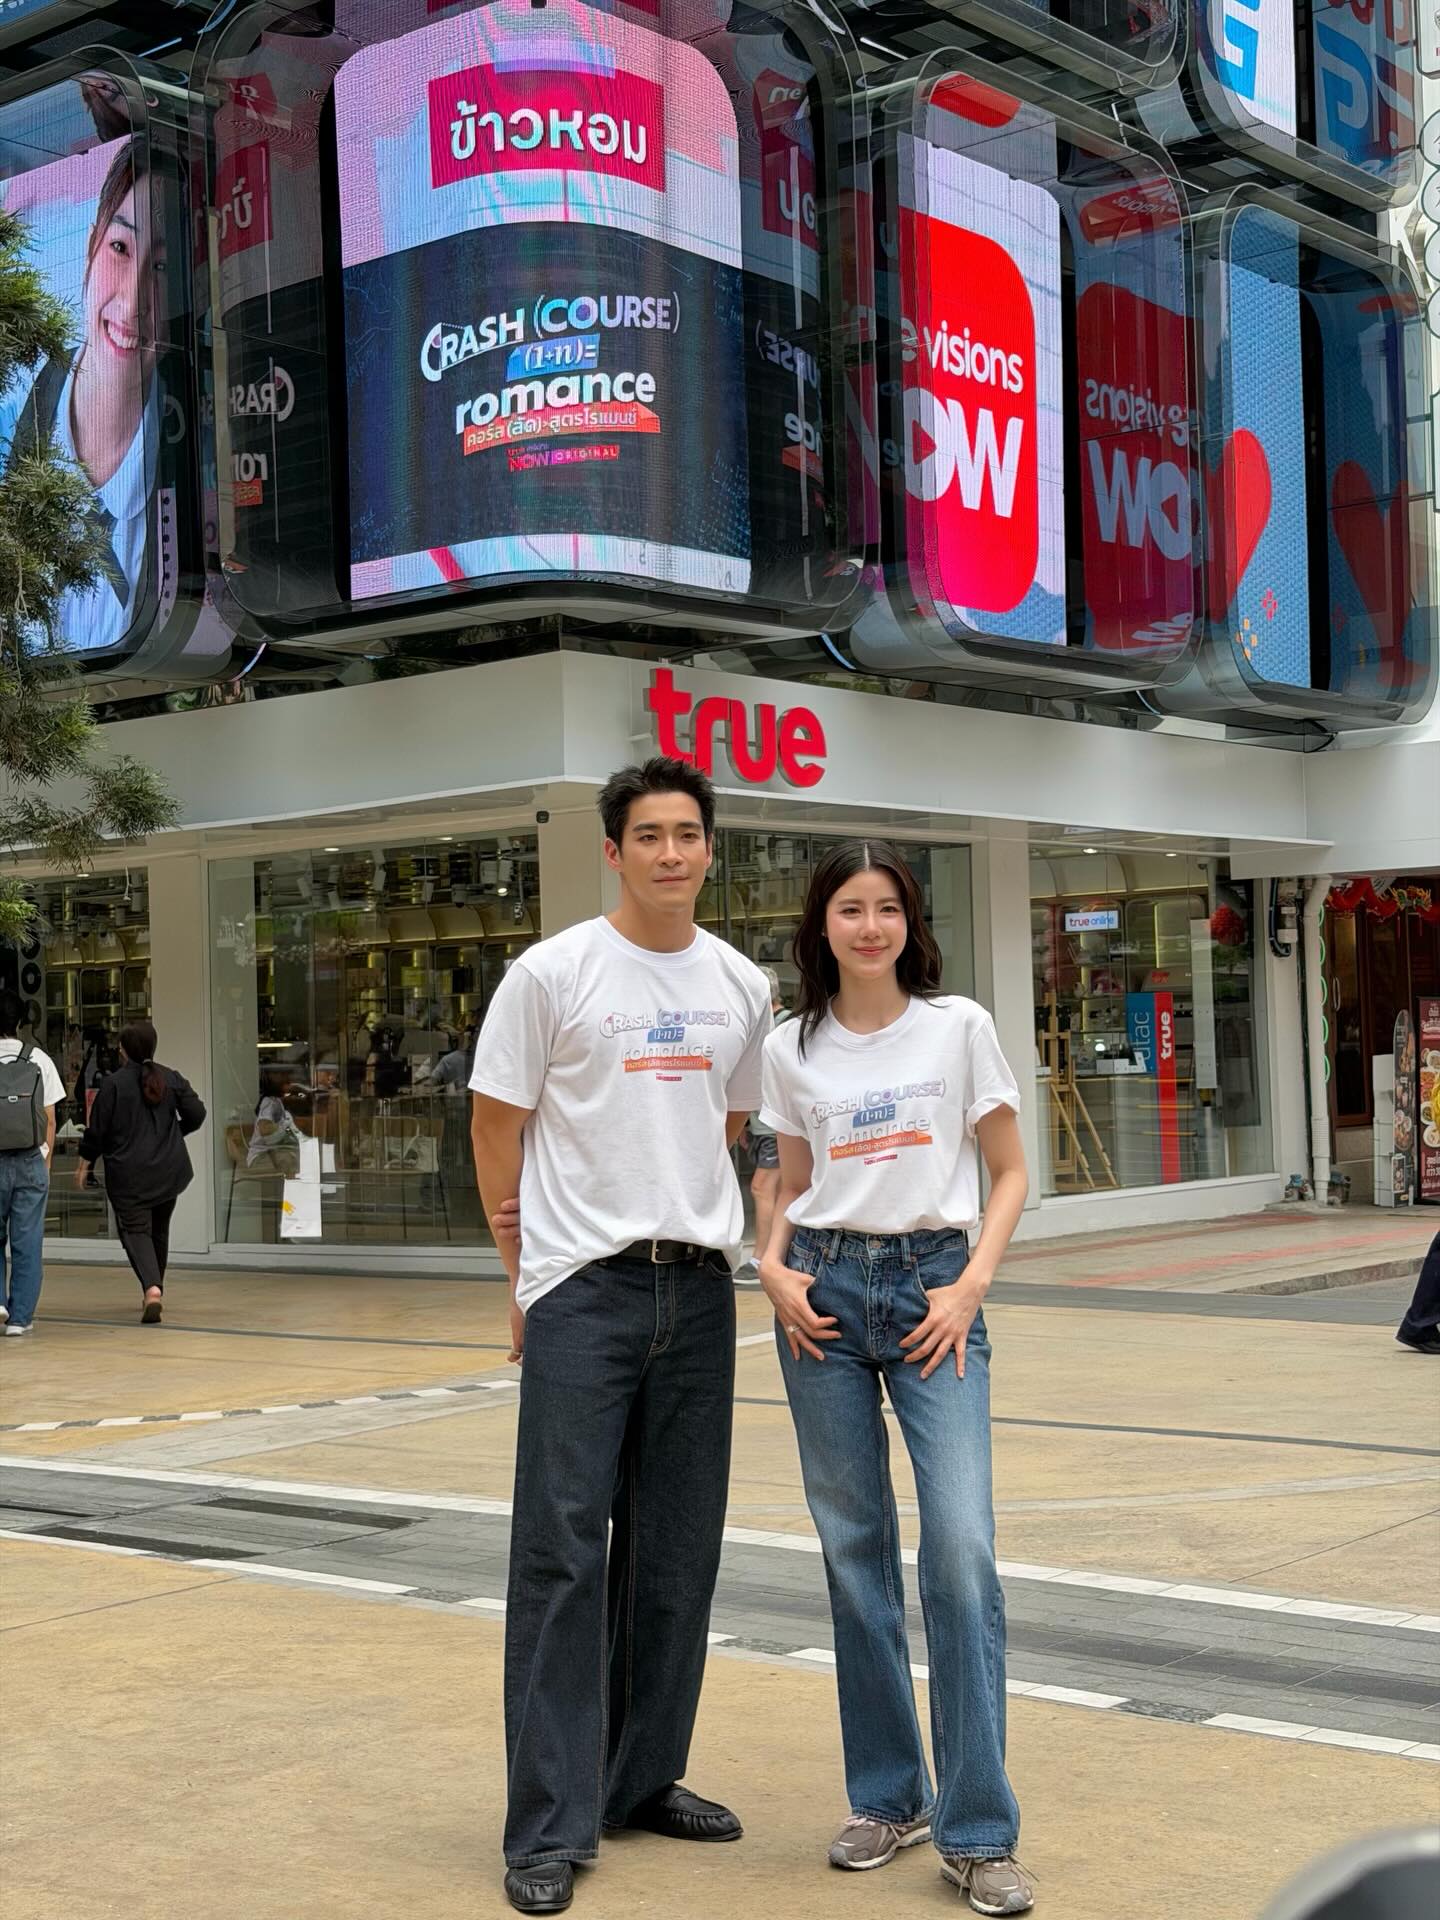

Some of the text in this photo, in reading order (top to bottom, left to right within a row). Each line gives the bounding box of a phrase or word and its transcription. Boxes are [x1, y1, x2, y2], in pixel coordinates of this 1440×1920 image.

[450, 99, 647, 165] ข้าวหอม
[420, 307, 525, 382] CRASH
[923, 319, 1024, 394] visions
[456, 371, 657, 435] romance
[647, 667, 828, 788] true
[1069, 917, 1089, 927] true
[1160, 1011, 1172, 1060] true
